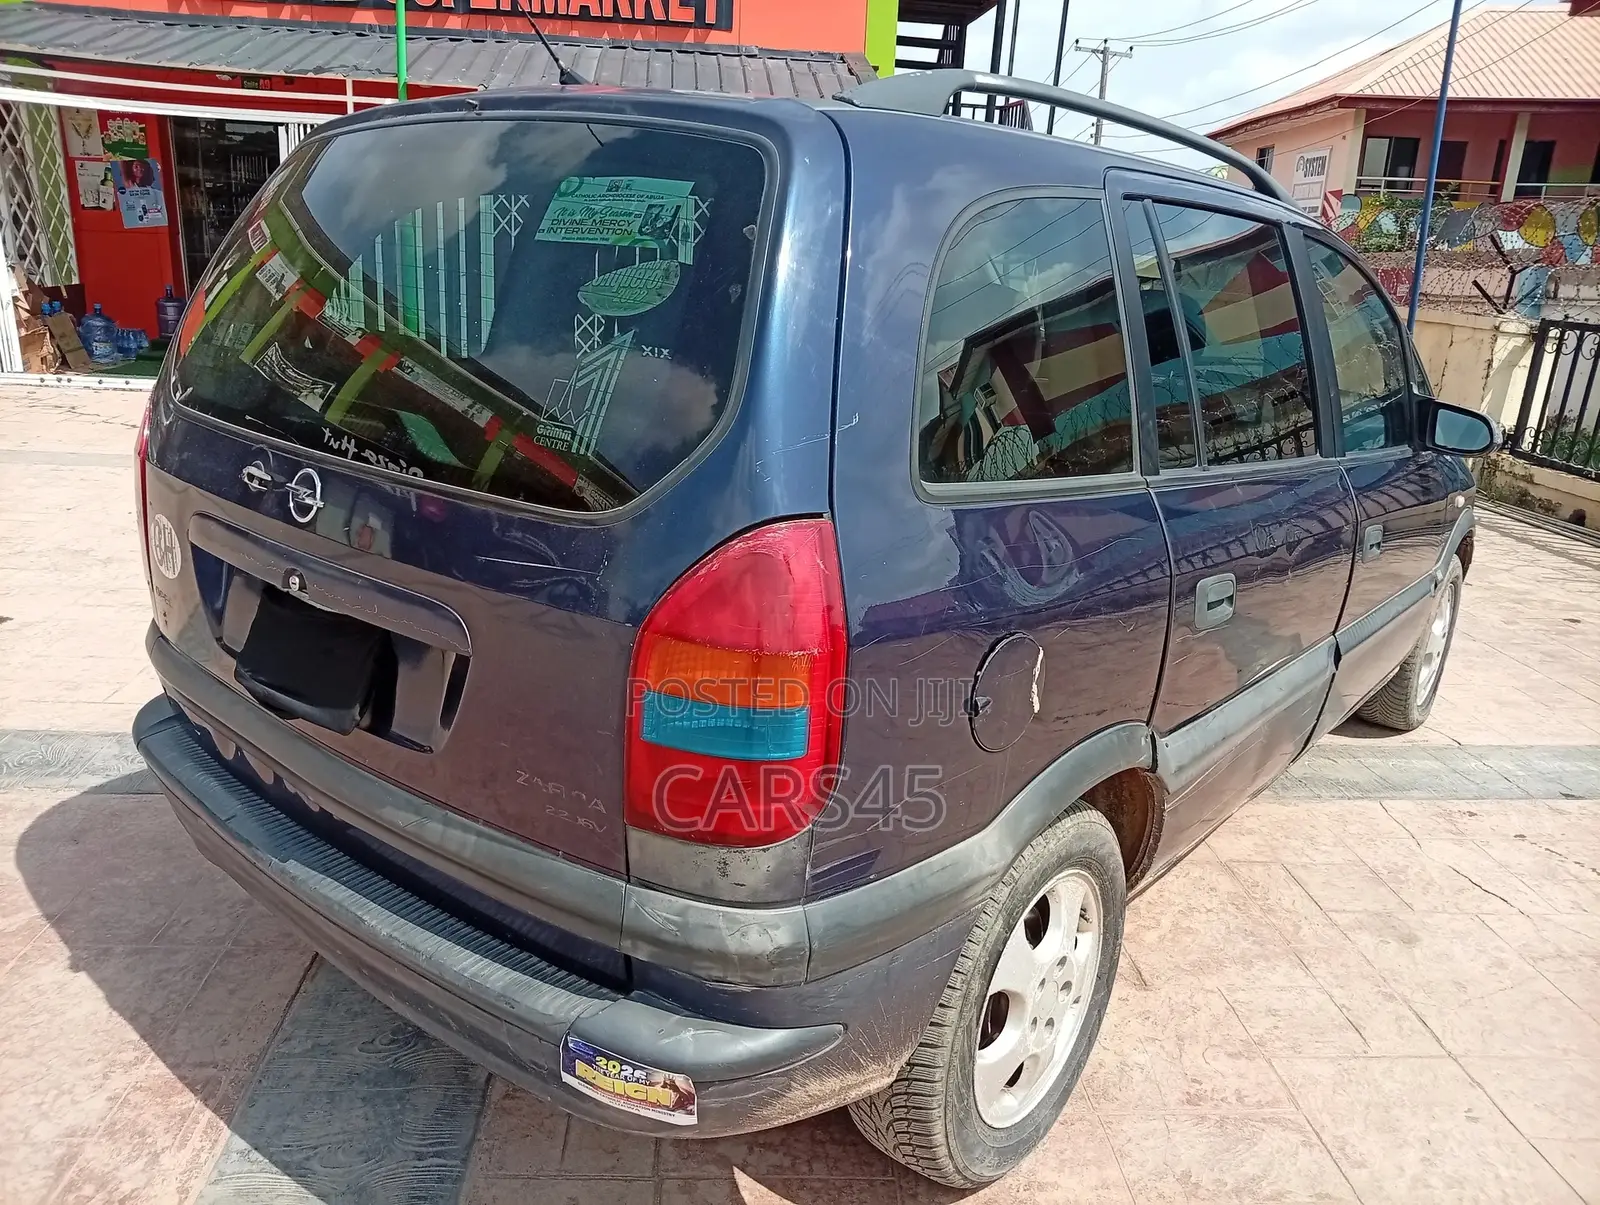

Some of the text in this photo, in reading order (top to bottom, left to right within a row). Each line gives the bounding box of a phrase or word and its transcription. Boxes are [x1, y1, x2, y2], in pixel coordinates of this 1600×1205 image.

[382, 0, 716, 24] MARKET
[1304, 155, 1327, 178] SYSTEM
[579, 205, 600, 219] My
[599, 205, 635, 219] Season
[545, 226, 634, 236] INTERVENTION
[551, 218, 636, 228] DIVINE MERCY
[533, 435, 570, 452] CENTRE
[575, 1058, 673, 1107] REIGN
[605, 1070, 626, 1081] YEAR
[626, 1075, 638, 1083] OF
[639, 1077, 652, 1086] MY
